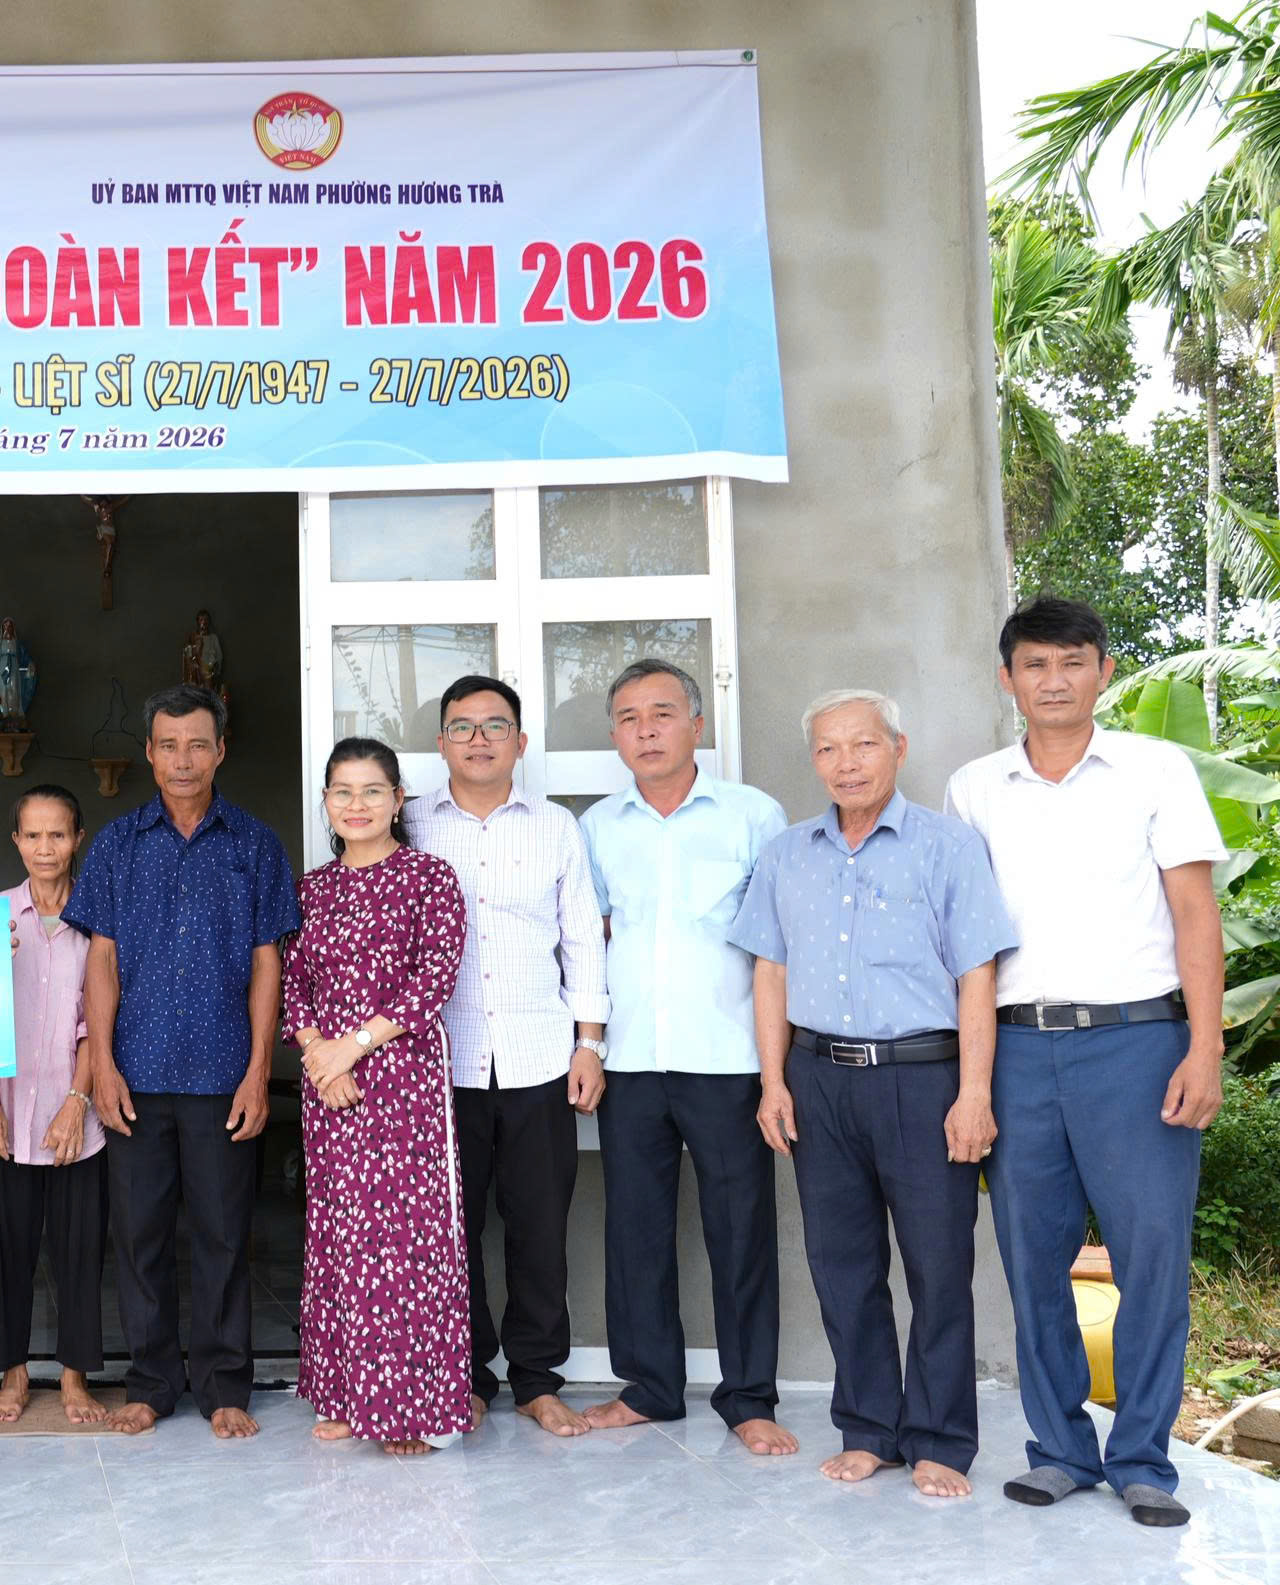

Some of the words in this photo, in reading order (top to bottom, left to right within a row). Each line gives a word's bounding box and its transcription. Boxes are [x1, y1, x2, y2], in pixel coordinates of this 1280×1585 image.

[92, 178, 116, 204] UỶ
[122, 183, 159, 204] BAN
[165, 183, 216, 206] MTTQ
[223, 180, 263, 208] VIỆT
[268, 183, 309, 204] NAM
[317, 180, 391, 205] PHƯỜNG
[398, 181, 462, 205] HƯƠNG
[468, 180, 504, 204] TRÀ
[167, 218, 318, 326] KẾT”
[344, 231, 497, 326] NĂM
[522, 239, 707, 323] 2026
[14, 354, 87, 415] LIỆT
[95, 354, 136, 408] SĨ
[144, 360, 330, 411] (27/7/1947
[370, 354, 570, 407] 27/7/2026)
[58, 428, 75, 449] 7
[82, 427, 148, 449] năm
[156, 427, 225, 448] 2026
